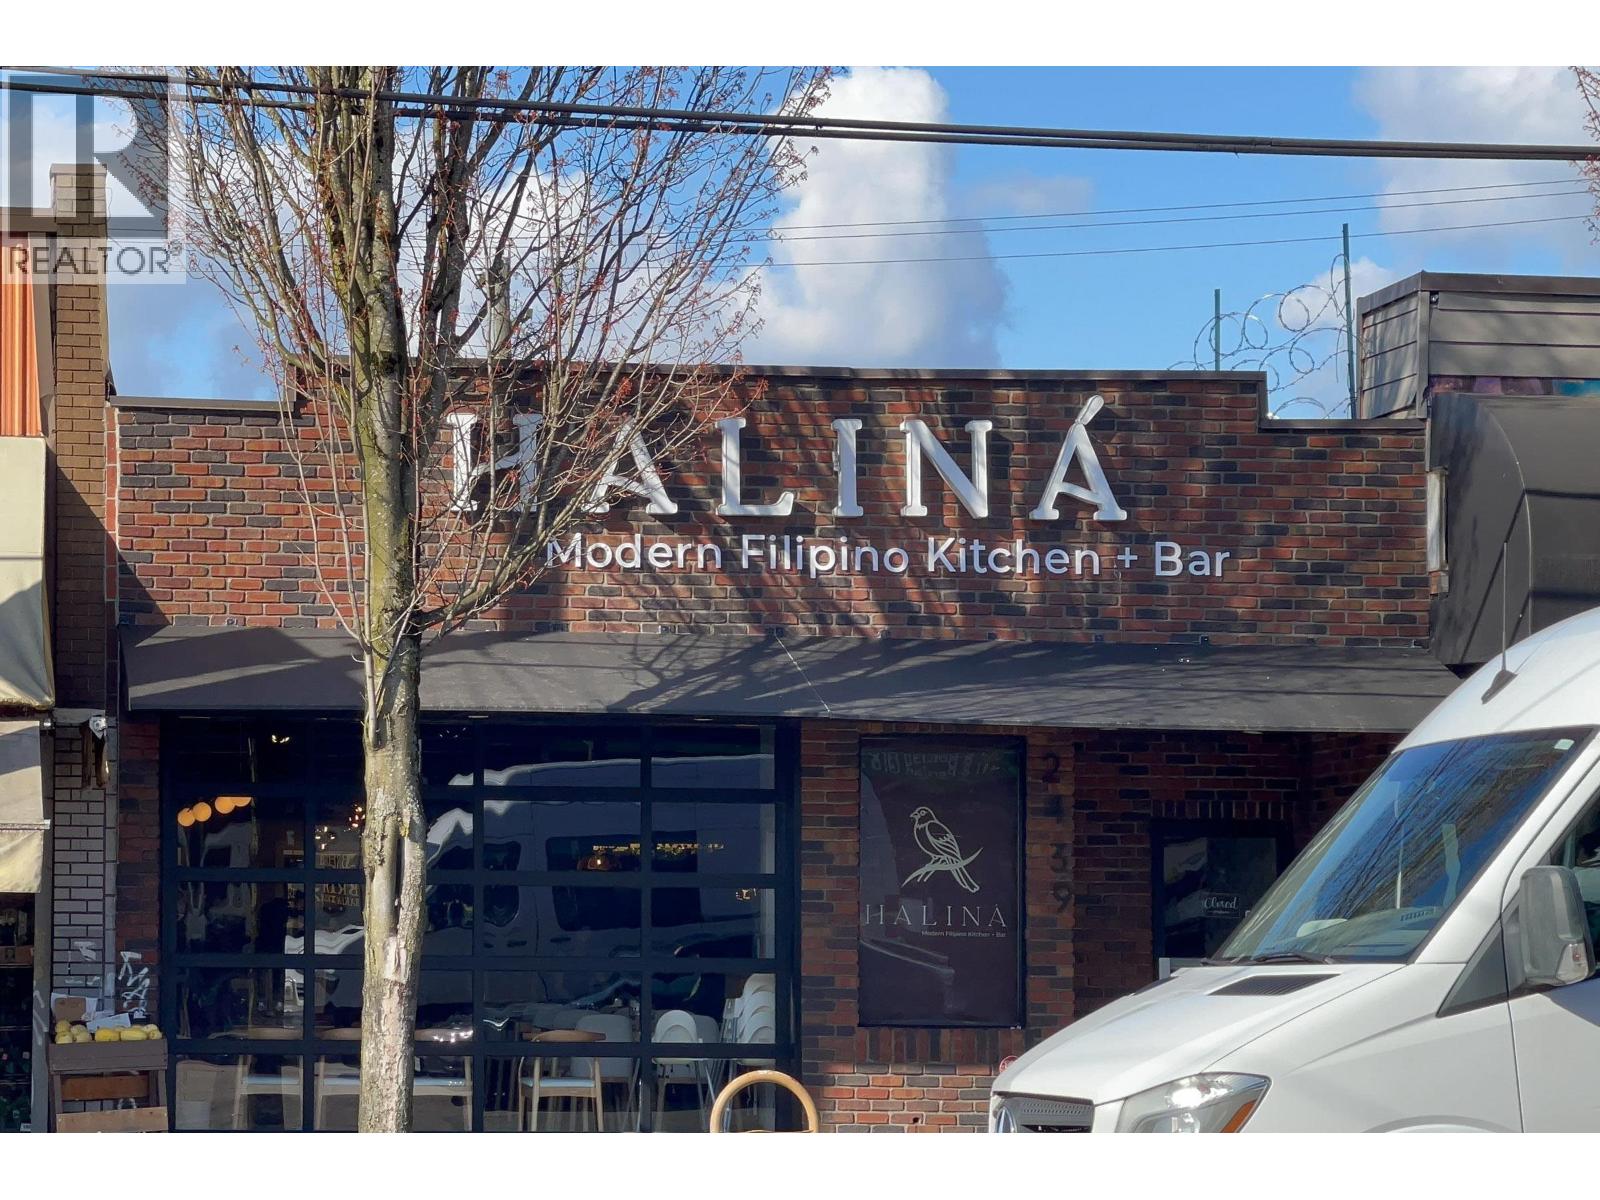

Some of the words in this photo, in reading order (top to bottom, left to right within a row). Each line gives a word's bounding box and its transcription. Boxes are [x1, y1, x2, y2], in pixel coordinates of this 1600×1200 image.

[546, 532, 722, 569] Modern
[742, 533, 909, 579] Filipino
[928, 536, 1099, 575] Kitchen
[1117, 553, 1138, 569] +
[1154, 541, 1231, 577] Bar
